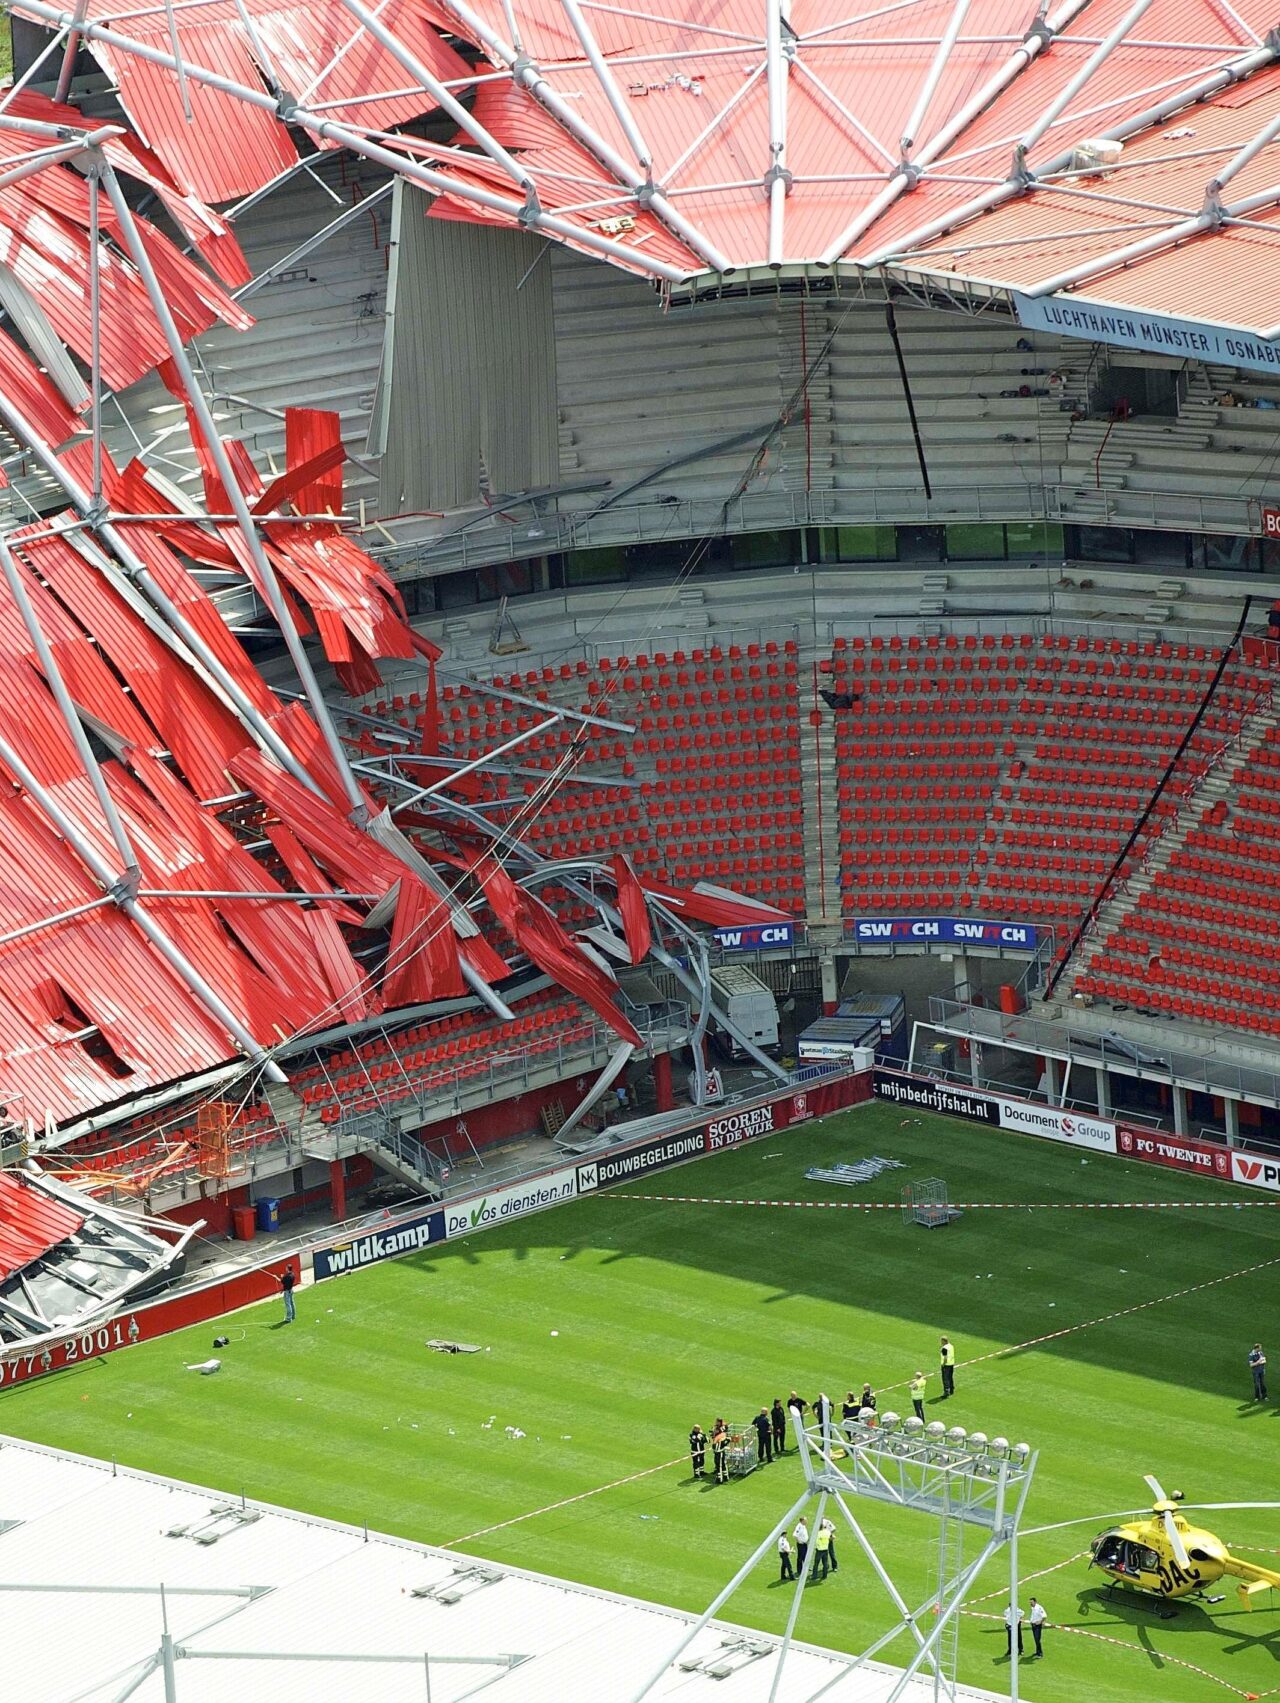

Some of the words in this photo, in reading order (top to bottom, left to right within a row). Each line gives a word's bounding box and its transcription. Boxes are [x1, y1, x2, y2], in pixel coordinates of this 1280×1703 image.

[1043, 306, 1137, 339] LUCHTHAVEN
[1140, 323, 1210, 352] MÜNSTER
[714, 927, 788, 947] WITCH
[859, 922, 939, 937] SWITCH
[953, 923, 1026, 942] SWITCH
[881, 1082, 989, 1118] mijnbedrijfshal.nl
[708, 1105, 773, 1139] SCOREN
[709, 1136, 723, 1150] IN
[726, 1131, 743, 1144] DE
[744, 1119, 775, 1140] WIJK
[1004, 1106, 1060, 1130] Document
[1077, 1122, 1111, 1142] Group
[599, 1134, 704, 1181] BOUWBEGELEIDING
[1136, 1138, 1154, 1153] FC
[1156, 1143, 1212, 1167] TWENTE
[449, 1216, 468, 1232] De
[500, 1178, 574, 1215] diensten.nl
[327, 1223, 430, 1273] wildkamp
[64, 1323, 125, 1361] 2001
[1152, 1559, 1201, 1595] DAC
